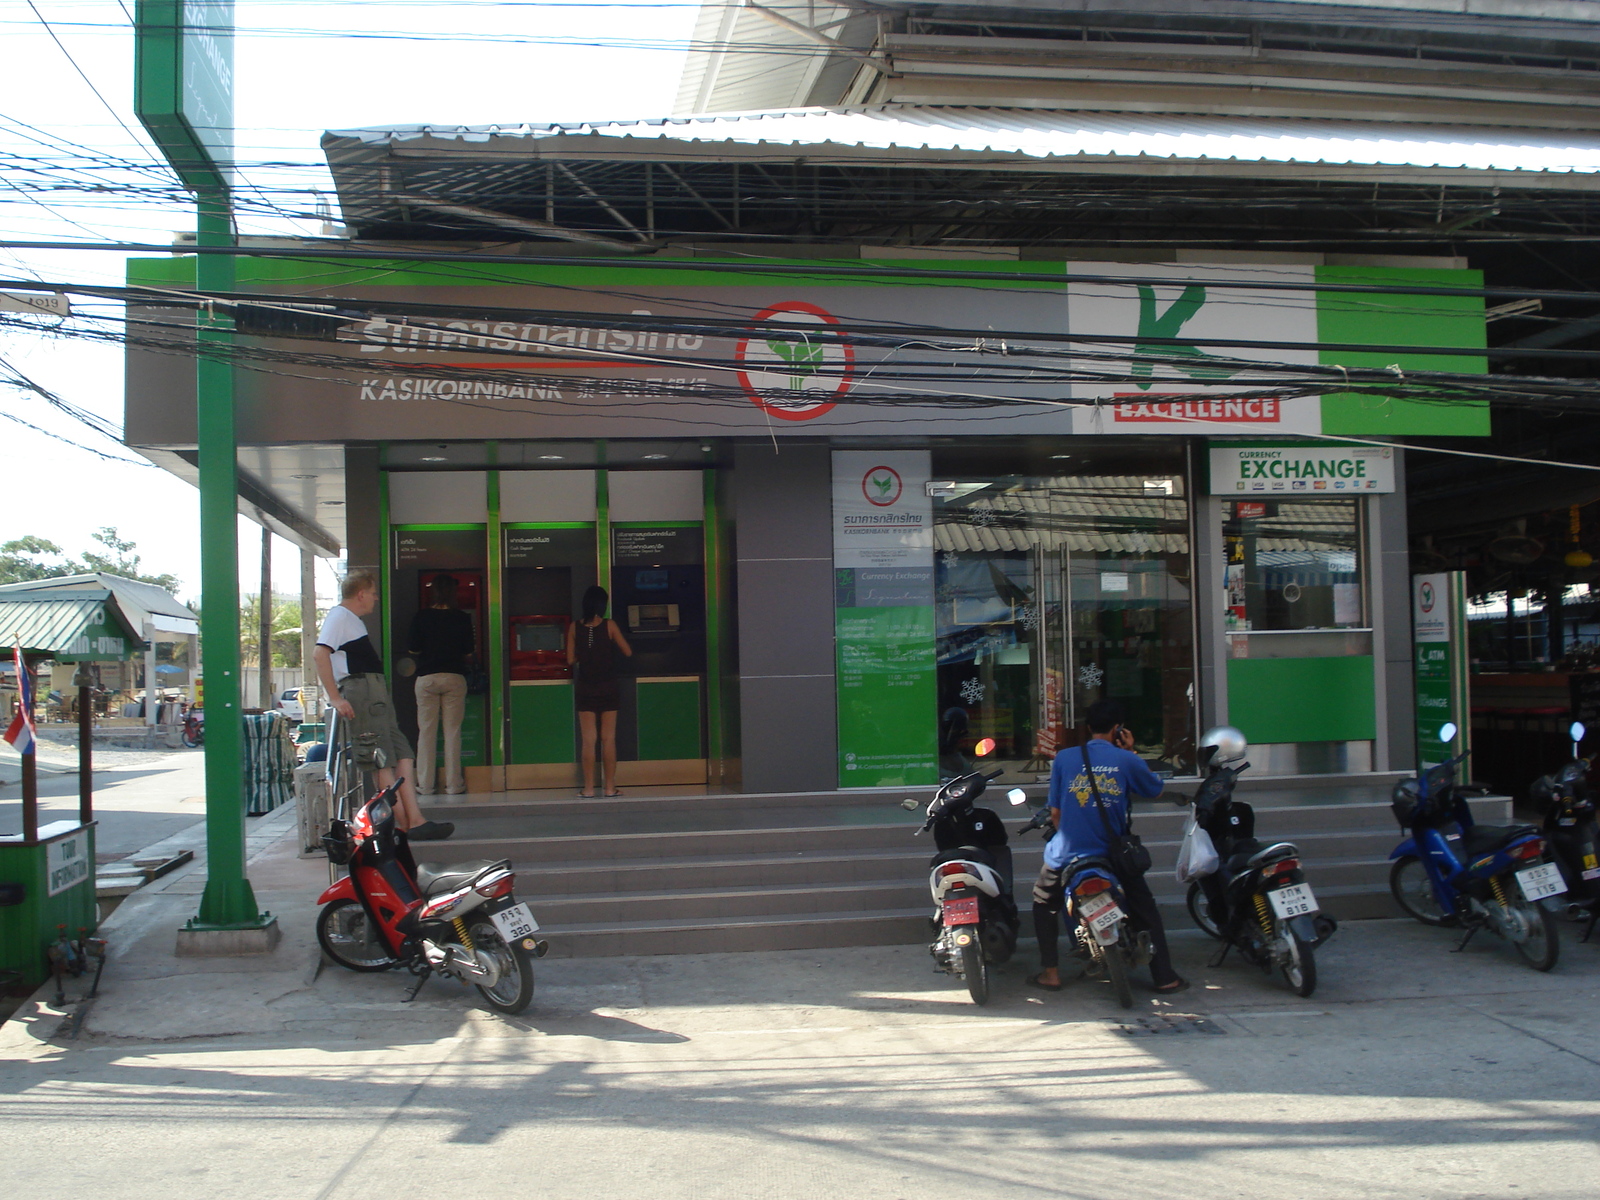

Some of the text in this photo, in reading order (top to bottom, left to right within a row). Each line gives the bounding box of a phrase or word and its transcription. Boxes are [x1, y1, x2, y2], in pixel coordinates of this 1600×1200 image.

[360, 379, 562, 401] KASIKORNBANK
[1120, 396, 1275, 418] EXCELLENCE
[1238, 451, 1282, 459] CURRENCY
[1240, 459, 1366, 478] EXCHANGE
[861, 572, 931, 581] Currency Exchange
[1081, 764, 1120, 774] Pttaya
[1286, 903, 1309, 915] 816
[1096, 910, 1118, 926] 555
[510, 923, 531, 938] 320
